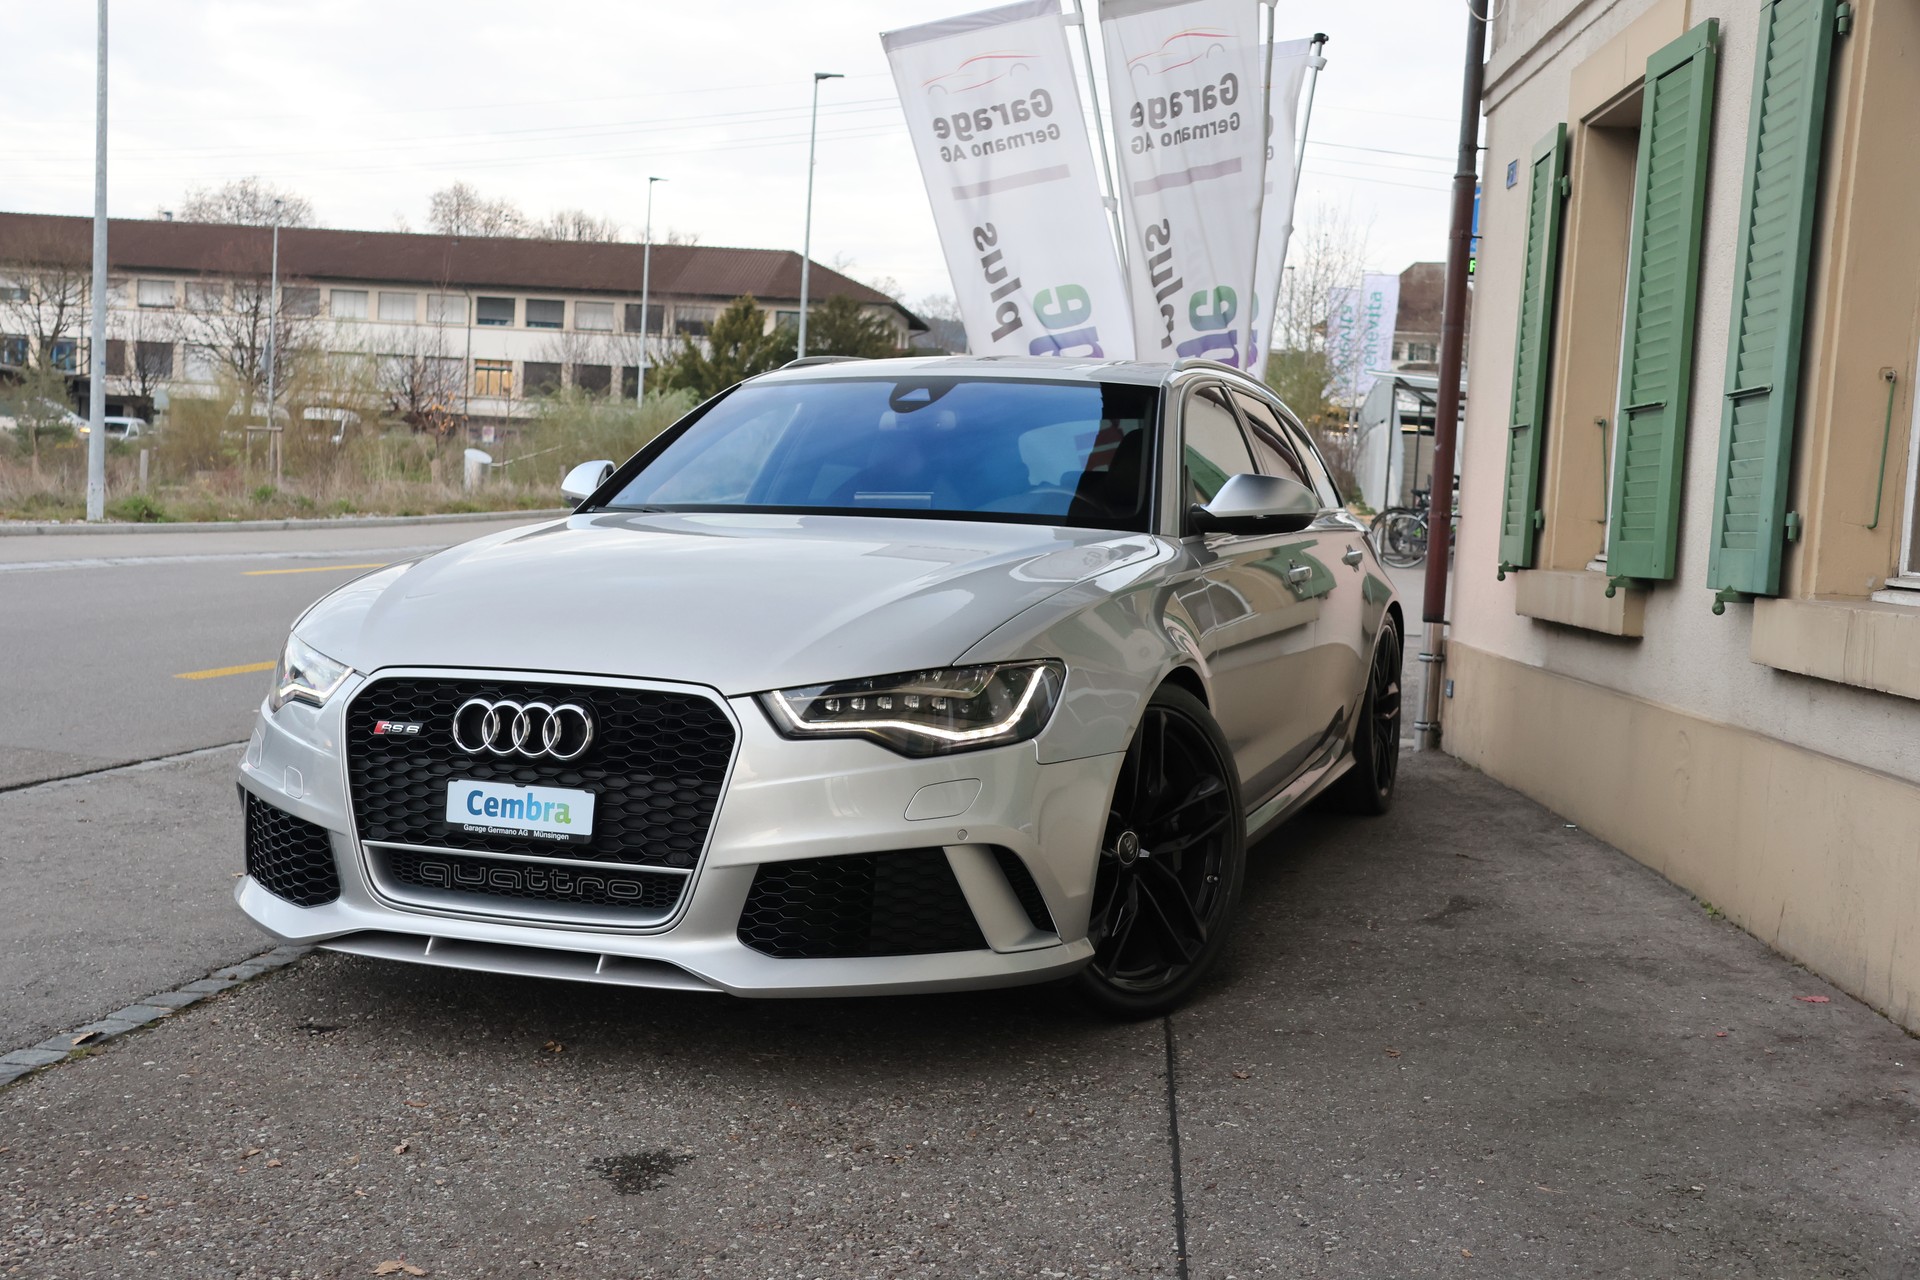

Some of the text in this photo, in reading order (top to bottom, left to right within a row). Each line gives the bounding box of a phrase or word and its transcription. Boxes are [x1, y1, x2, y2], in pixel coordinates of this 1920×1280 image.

[466, 789, 572, 825] Cembra
[463, 823, 569, 841] Garage Germano AG Münsingen
[419, 861, 643, 899] quattro
